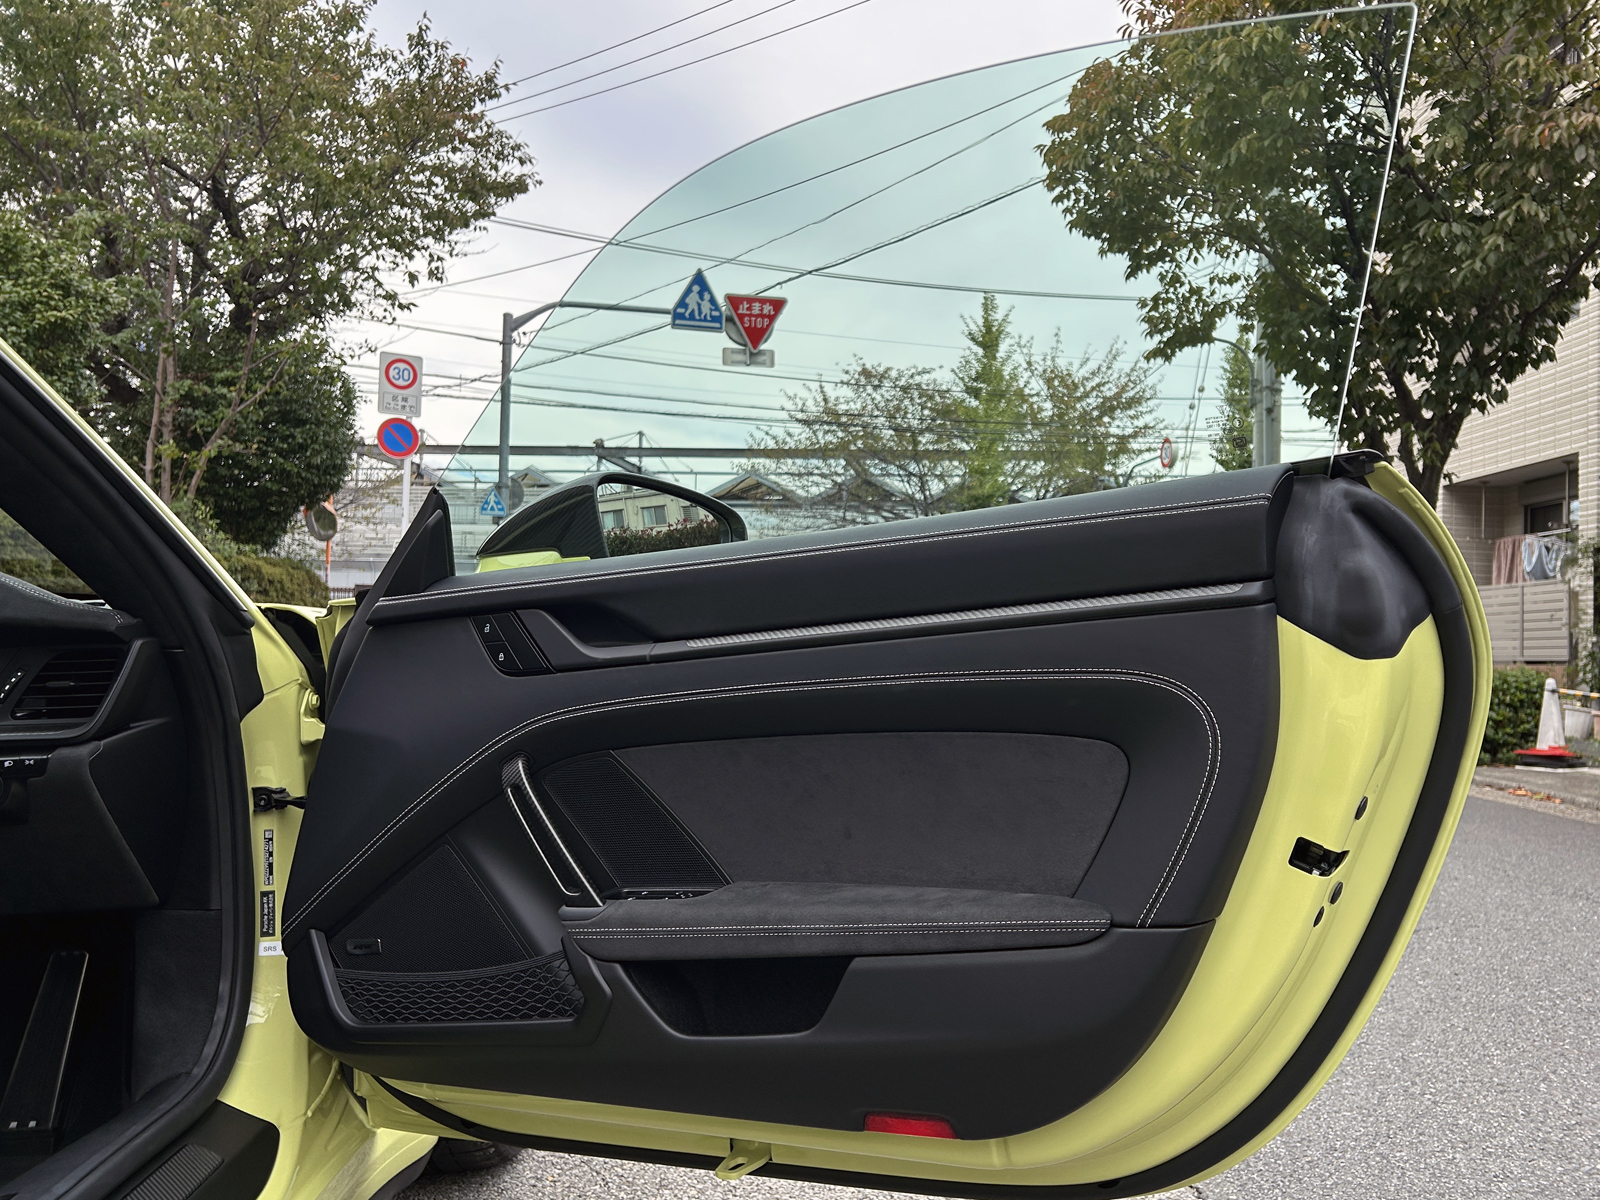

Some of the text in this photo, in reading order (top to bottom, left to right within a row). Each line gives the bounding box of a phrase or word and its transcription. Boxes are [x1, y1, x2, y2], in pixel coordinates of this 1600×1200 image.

[737, 301, 775, 315] 止まれ
[744, 317, 770, 328] STOP
[392, 366, 411, 382] 30
[263, 945, 277, 953] SRS
